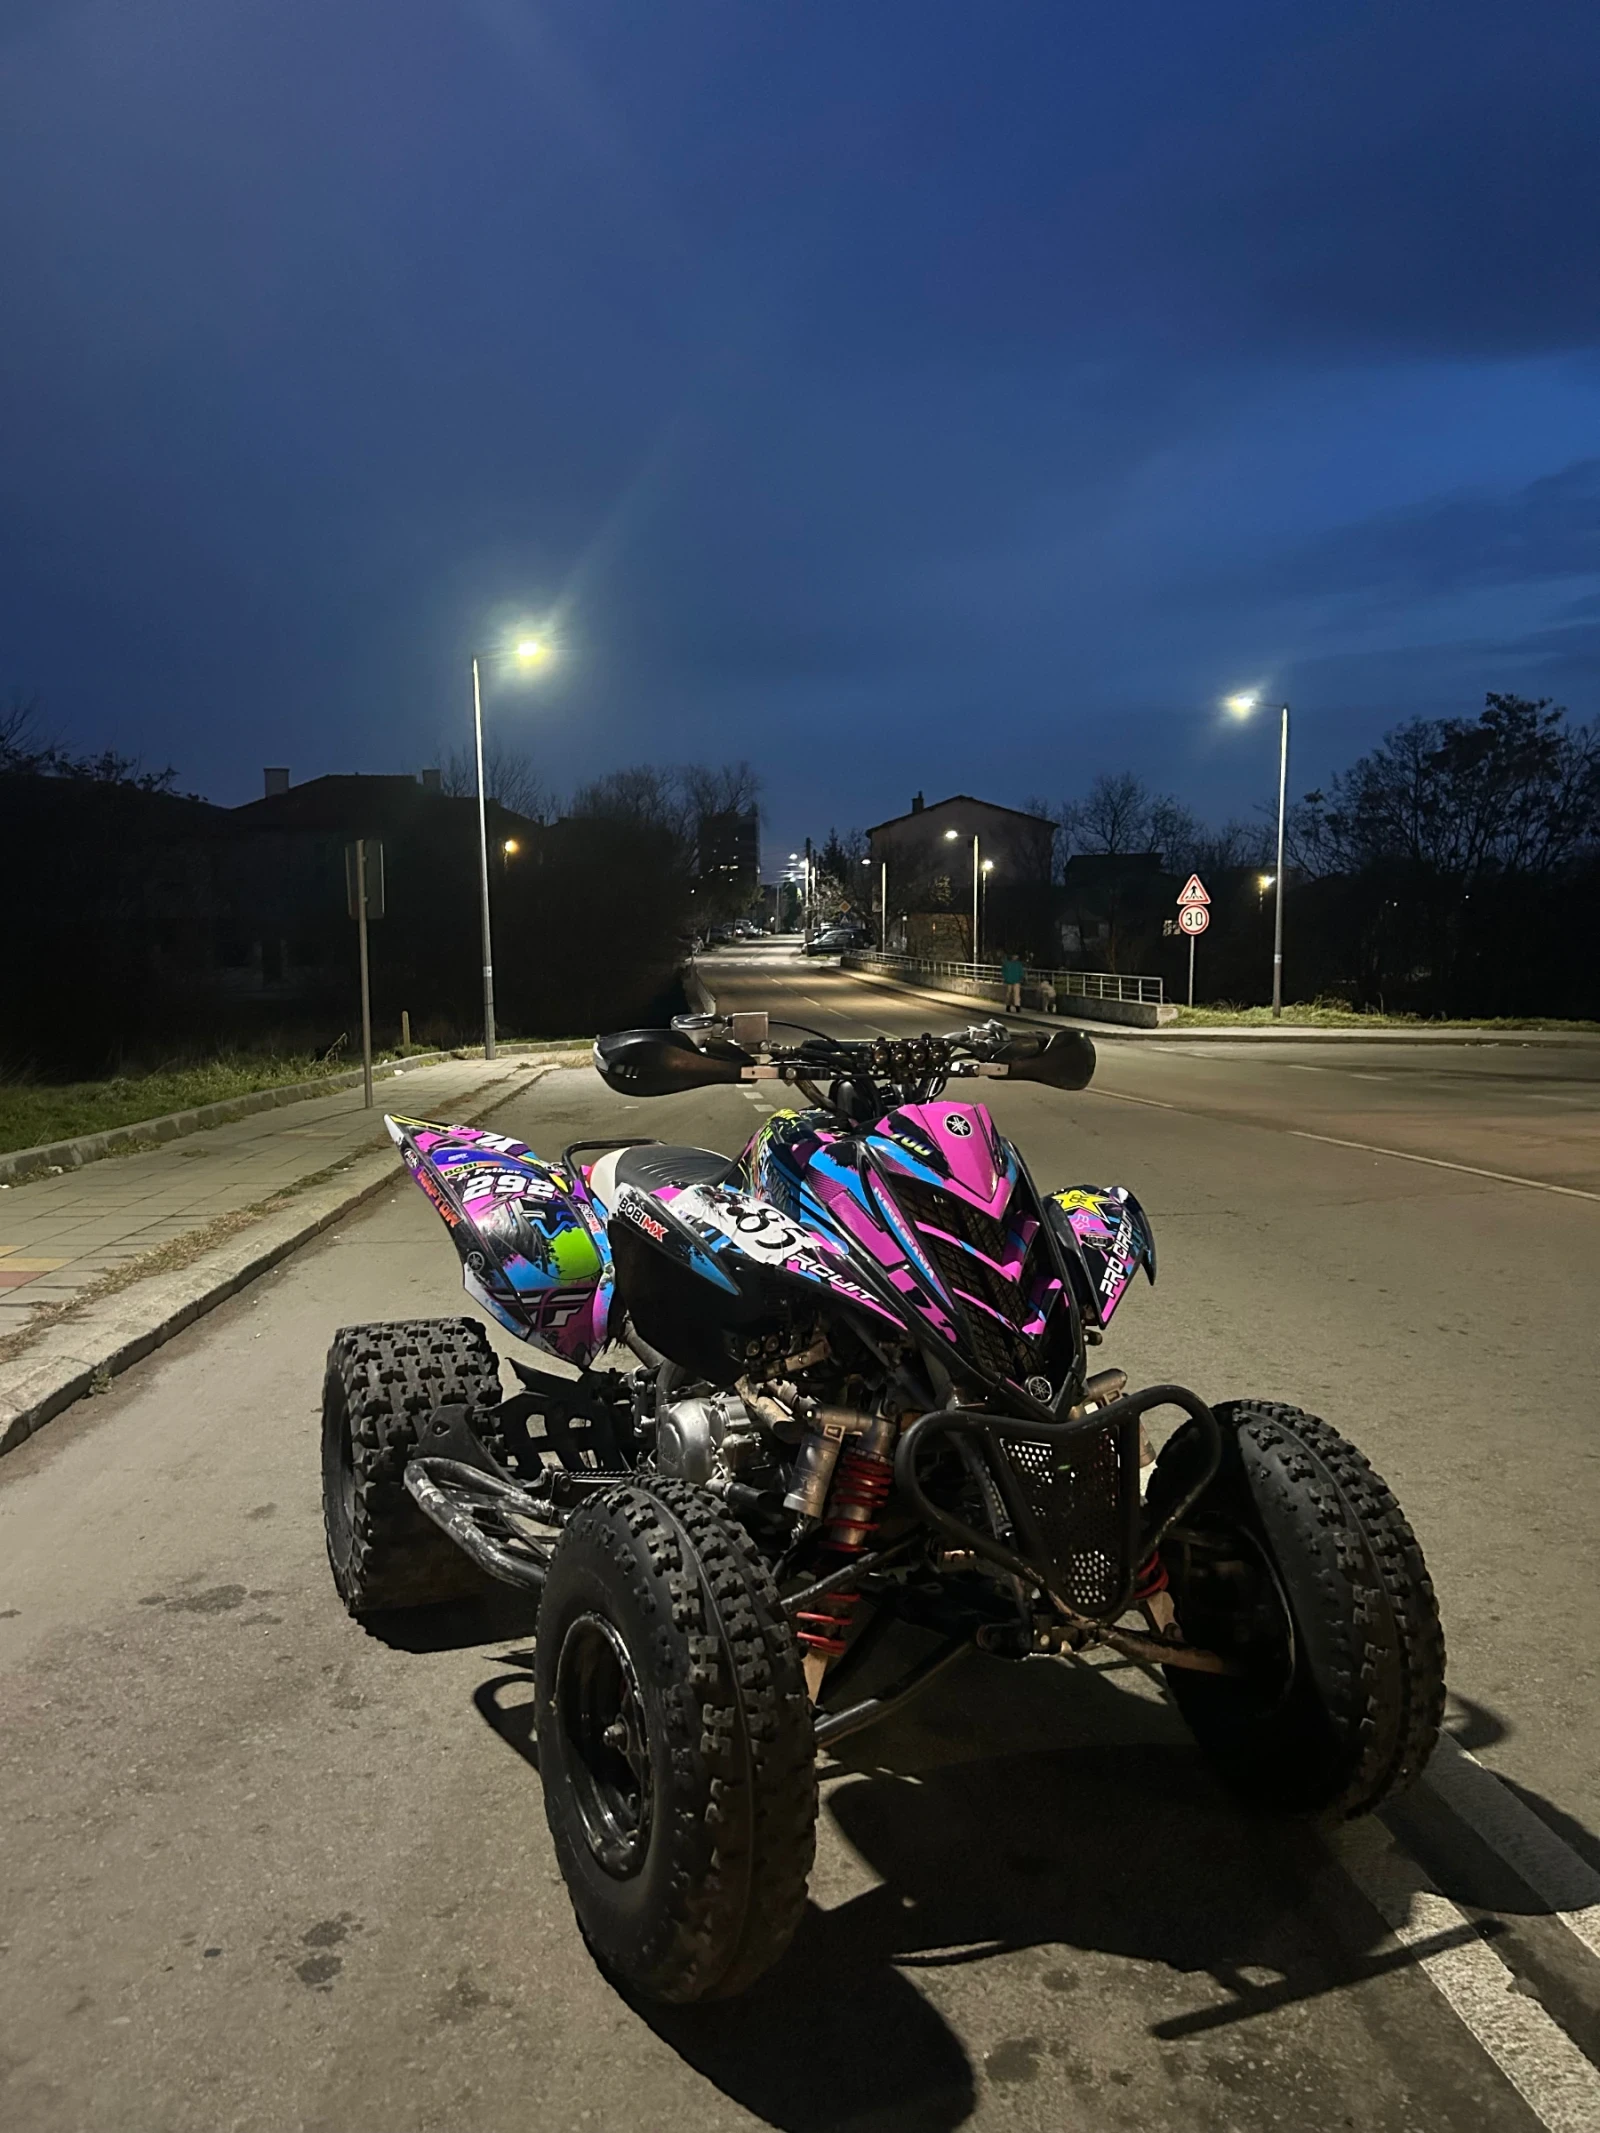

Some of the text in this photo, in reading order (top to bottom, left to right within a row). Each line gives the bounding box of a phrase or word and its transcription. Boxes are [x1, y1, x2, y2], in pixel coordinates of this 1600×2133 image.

[1185, 911, 1203, 926] 30
[418, 1168, 461, 1228] RAPTOR
[462, 1174, 557, 1203] 292
[619, 1197, 669, 1242] BOBIMX
[901, 1227, 935, 1280] SCANIA
[787, 1252, 880, 1303] RCUIT
[1099, 1256, 1125, 1298] PRO
